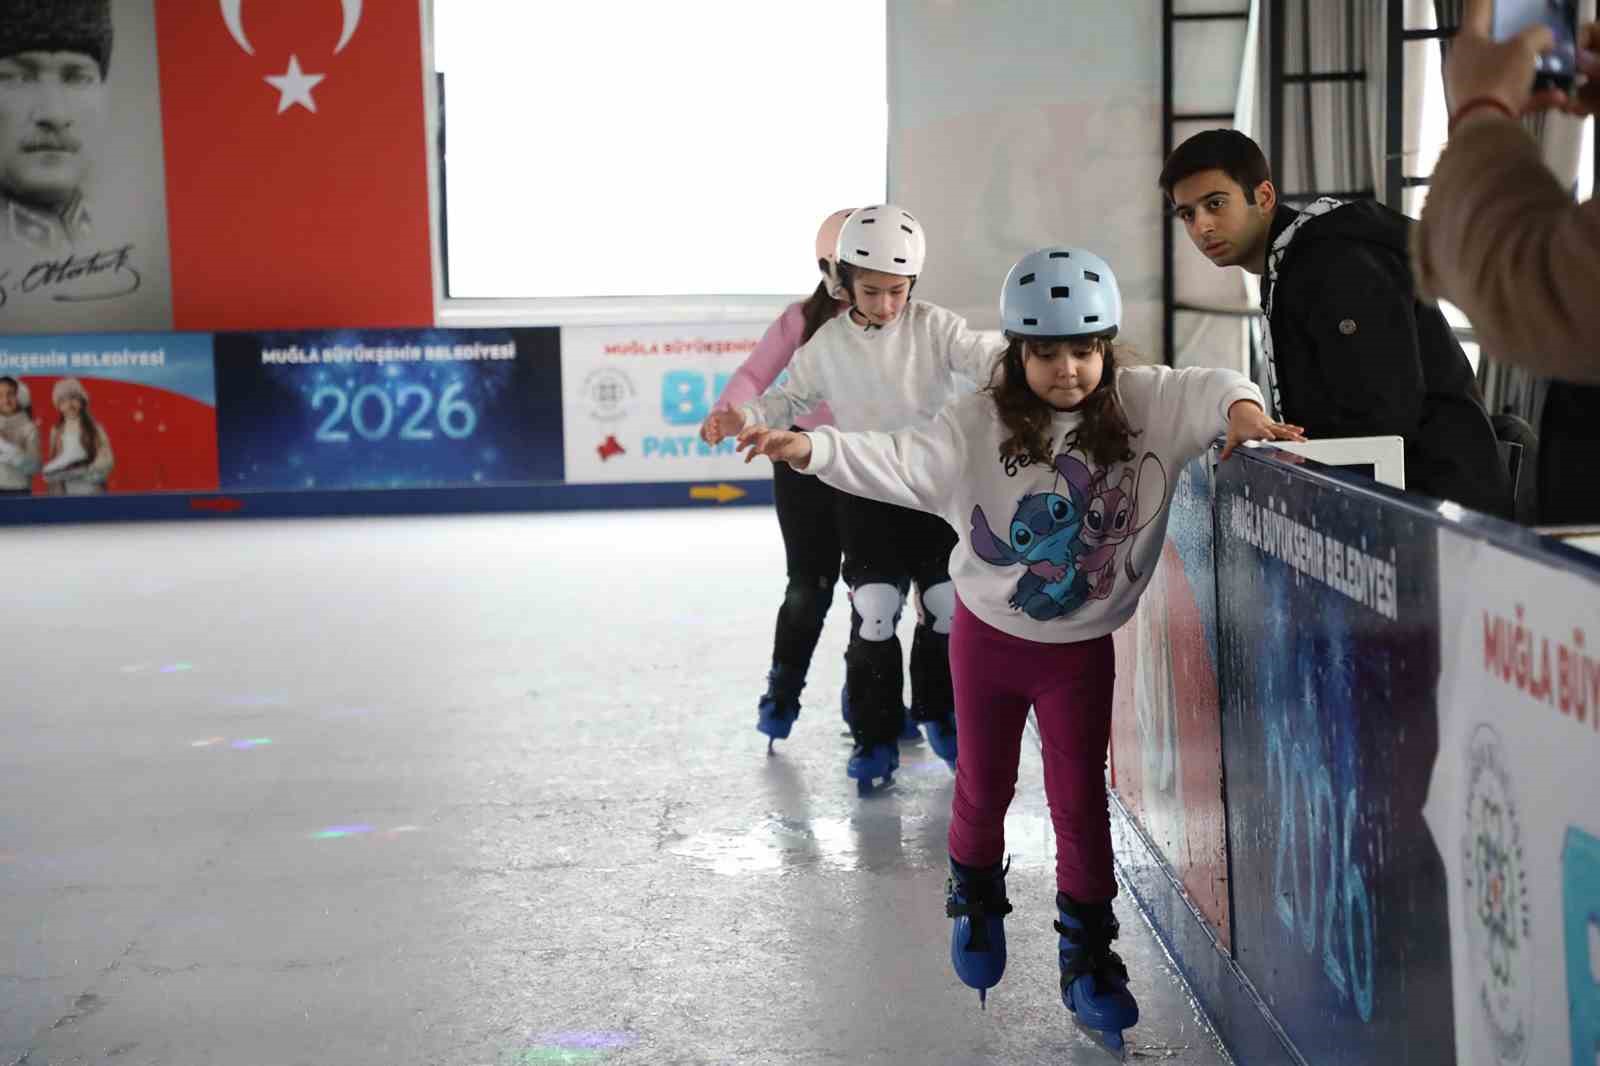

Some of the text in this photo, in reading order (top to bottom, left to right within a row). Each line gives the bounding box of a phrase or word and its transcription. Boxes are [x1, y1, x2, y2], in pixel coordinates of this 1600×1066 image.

[71, 347, 166, 368] BELEDİYESİ
[261, 340, 517, 366] MUĞLA BÜYÜKŞEHİR BELEDİYESİ
[311, 383, 477, 442] 2026
[1324, 535, 1398, 622] BELEDİYESİ
[1482, 602, 1552, 703] MUĞLA
